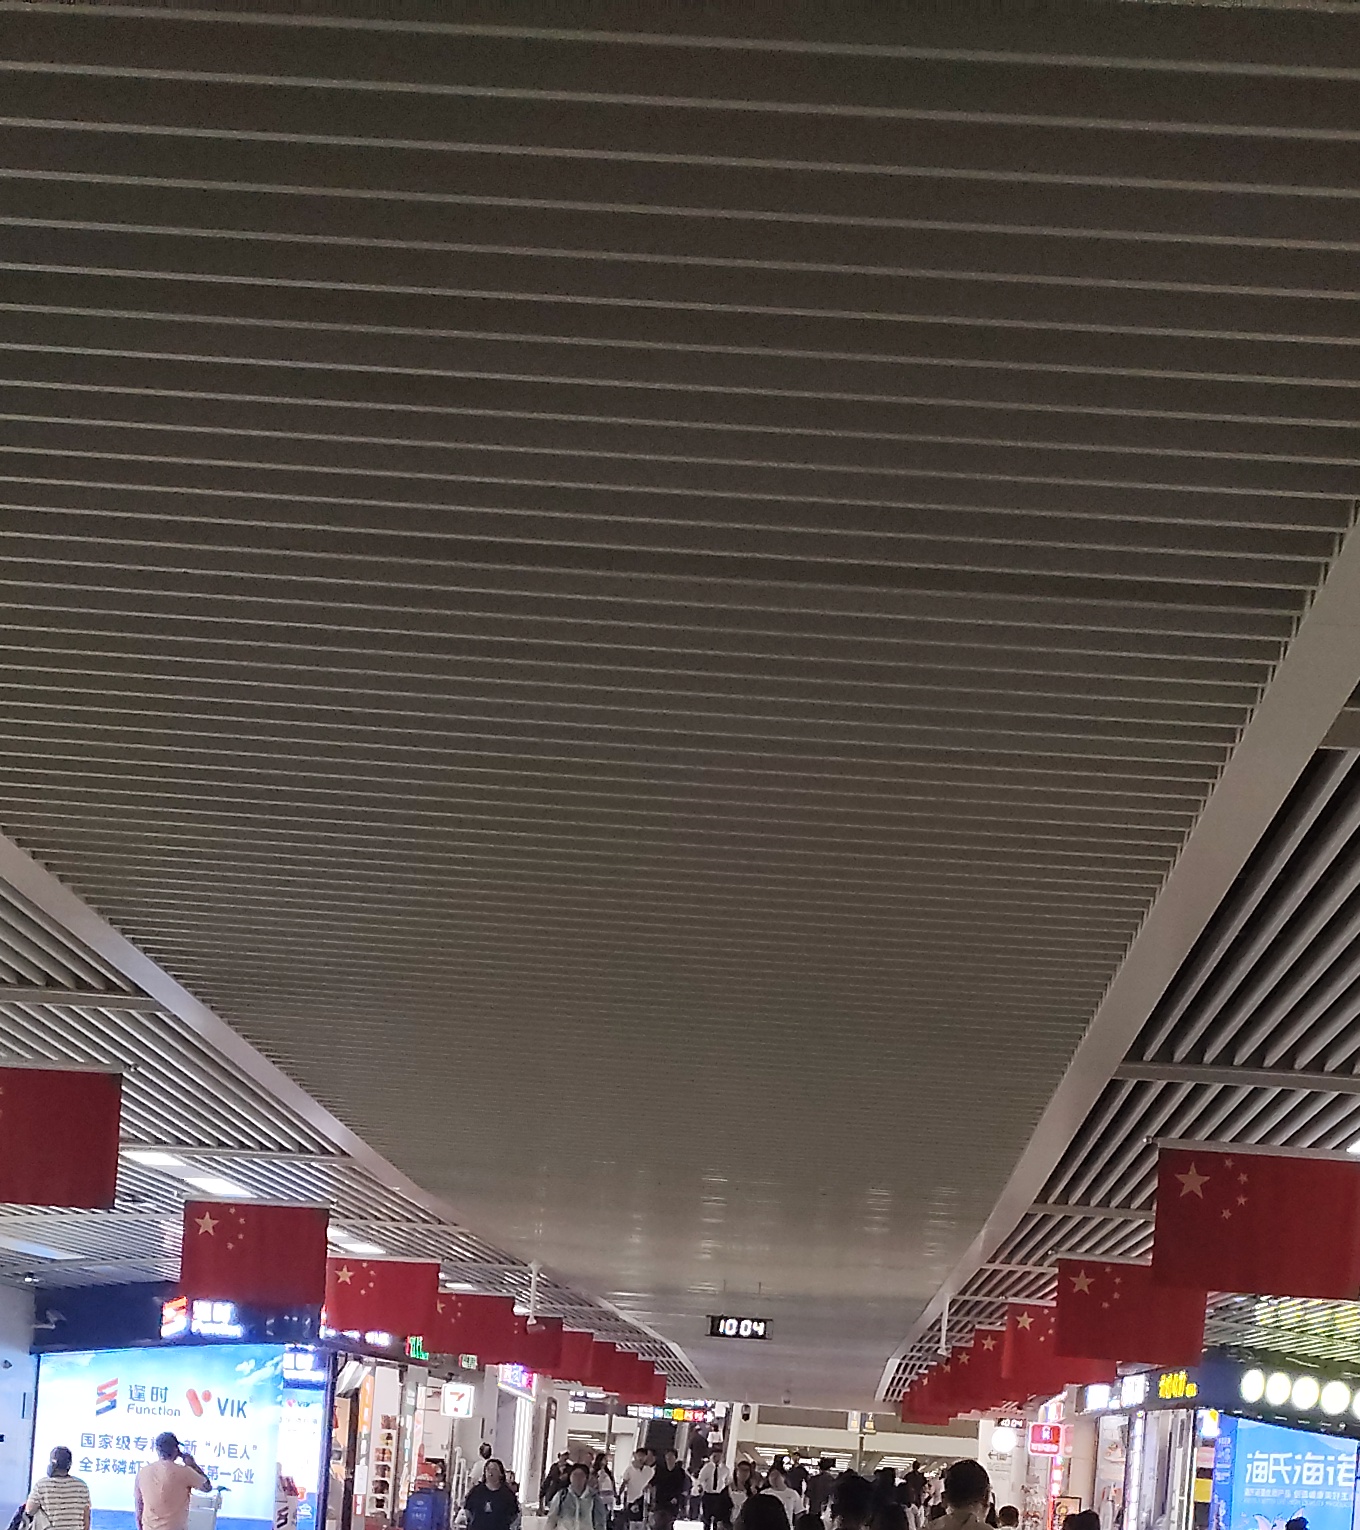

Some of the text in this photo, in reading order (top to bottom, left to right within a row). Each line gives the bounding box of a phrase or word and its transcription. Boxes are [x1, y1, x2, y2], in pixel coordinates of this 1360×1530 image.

[127, 1403, 181, 1417] Function
[217, 1397, 248, 1419] VIK
[1245, 1450, 1356, 1487] 海氏海诺
